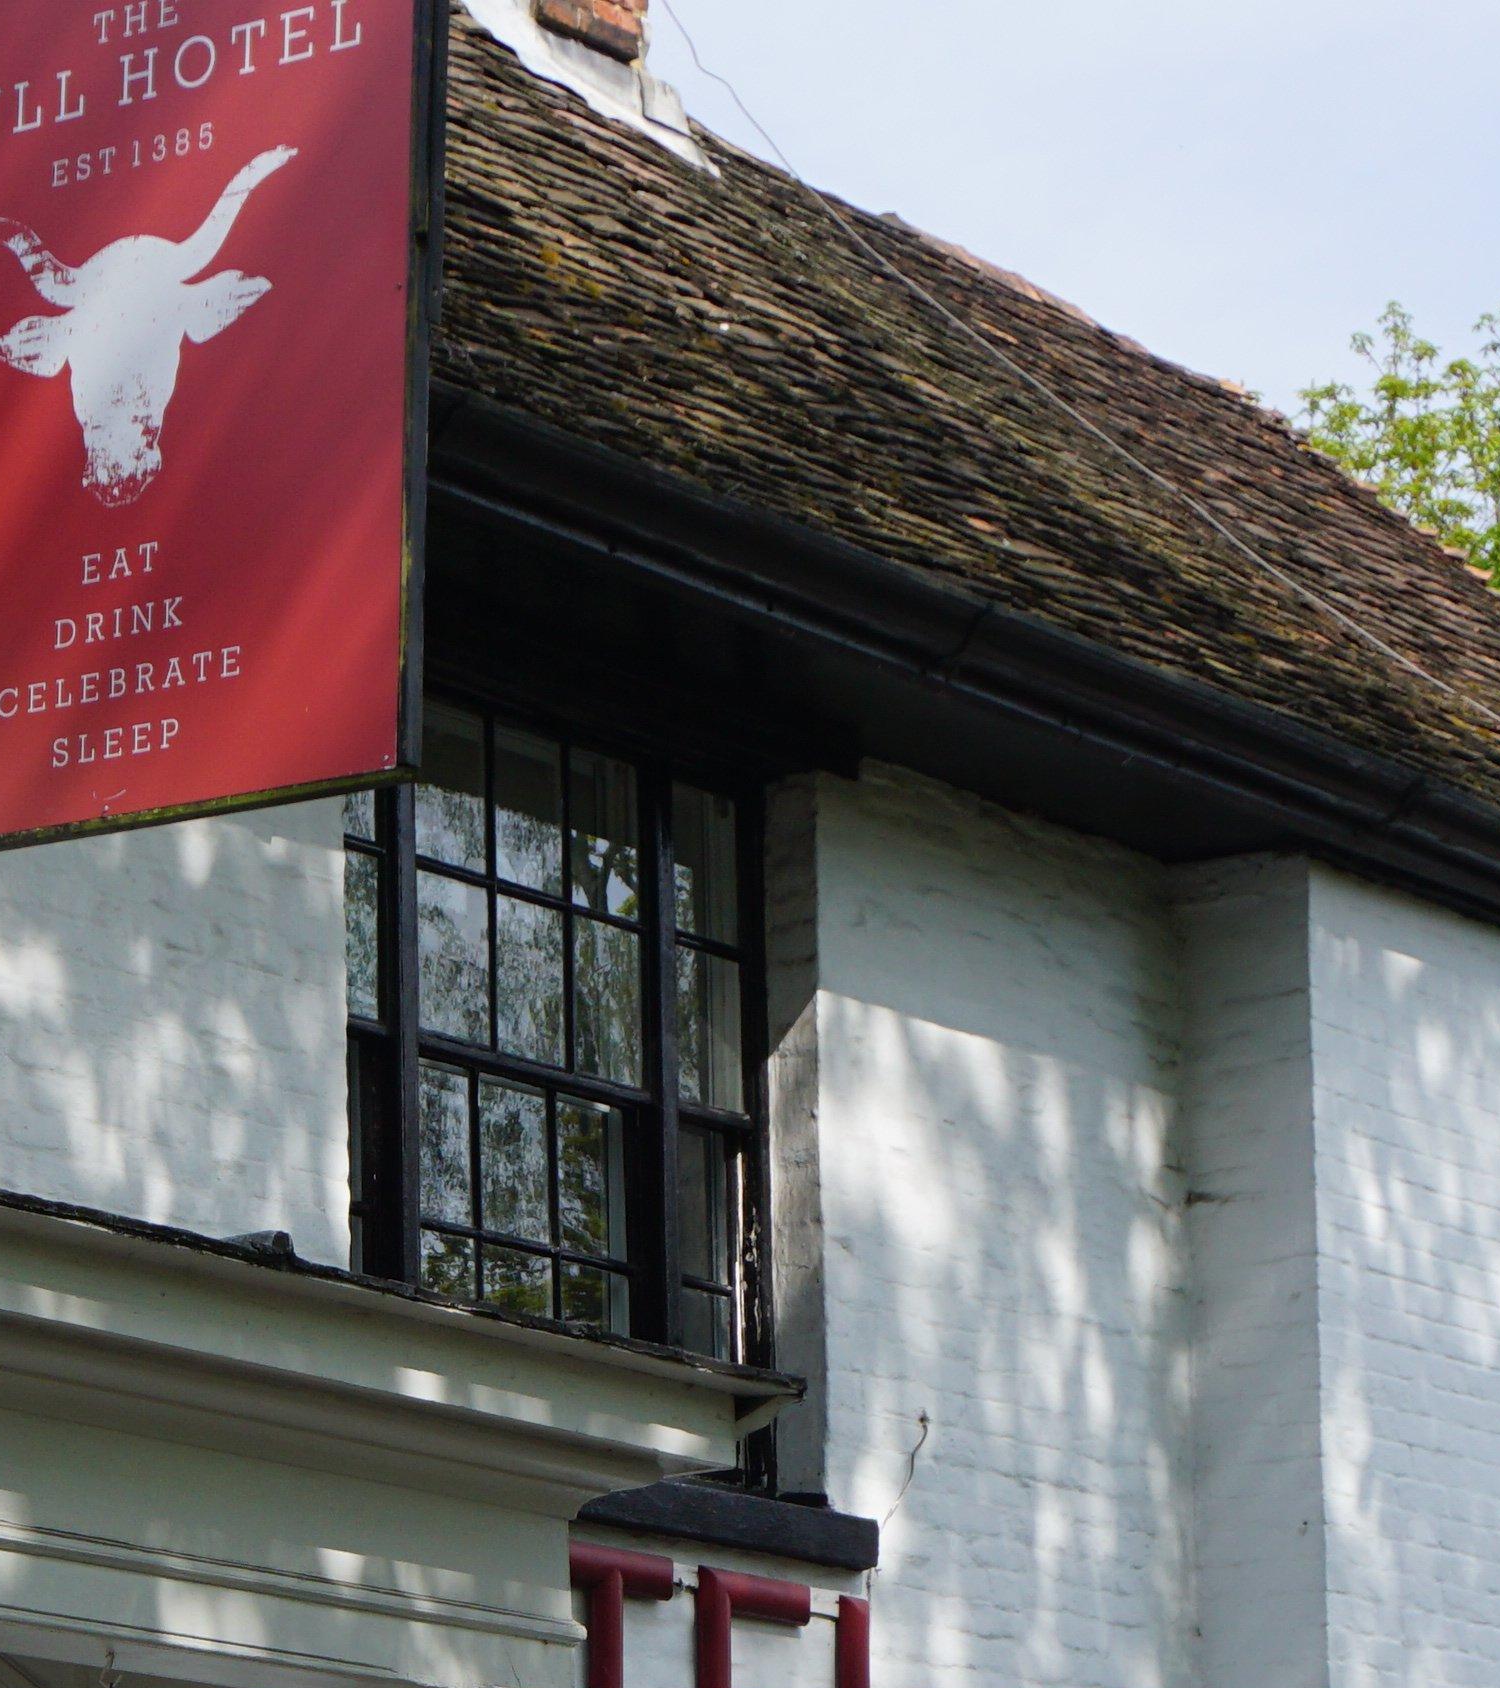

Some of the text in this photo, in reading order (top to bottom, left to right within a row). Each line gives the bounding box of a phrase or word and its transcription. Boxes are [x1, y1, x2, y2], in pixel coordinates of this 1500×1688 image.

[93, 0, 179, 45] THE
[117, 0, 363, 107] HOTEL
[51, 122, 215, 188] EST 1385
[81, 541, 160, 586] EAT
[53, 595, 184, 650] DRINK
[51, 718, 181, 769] SLEEP
